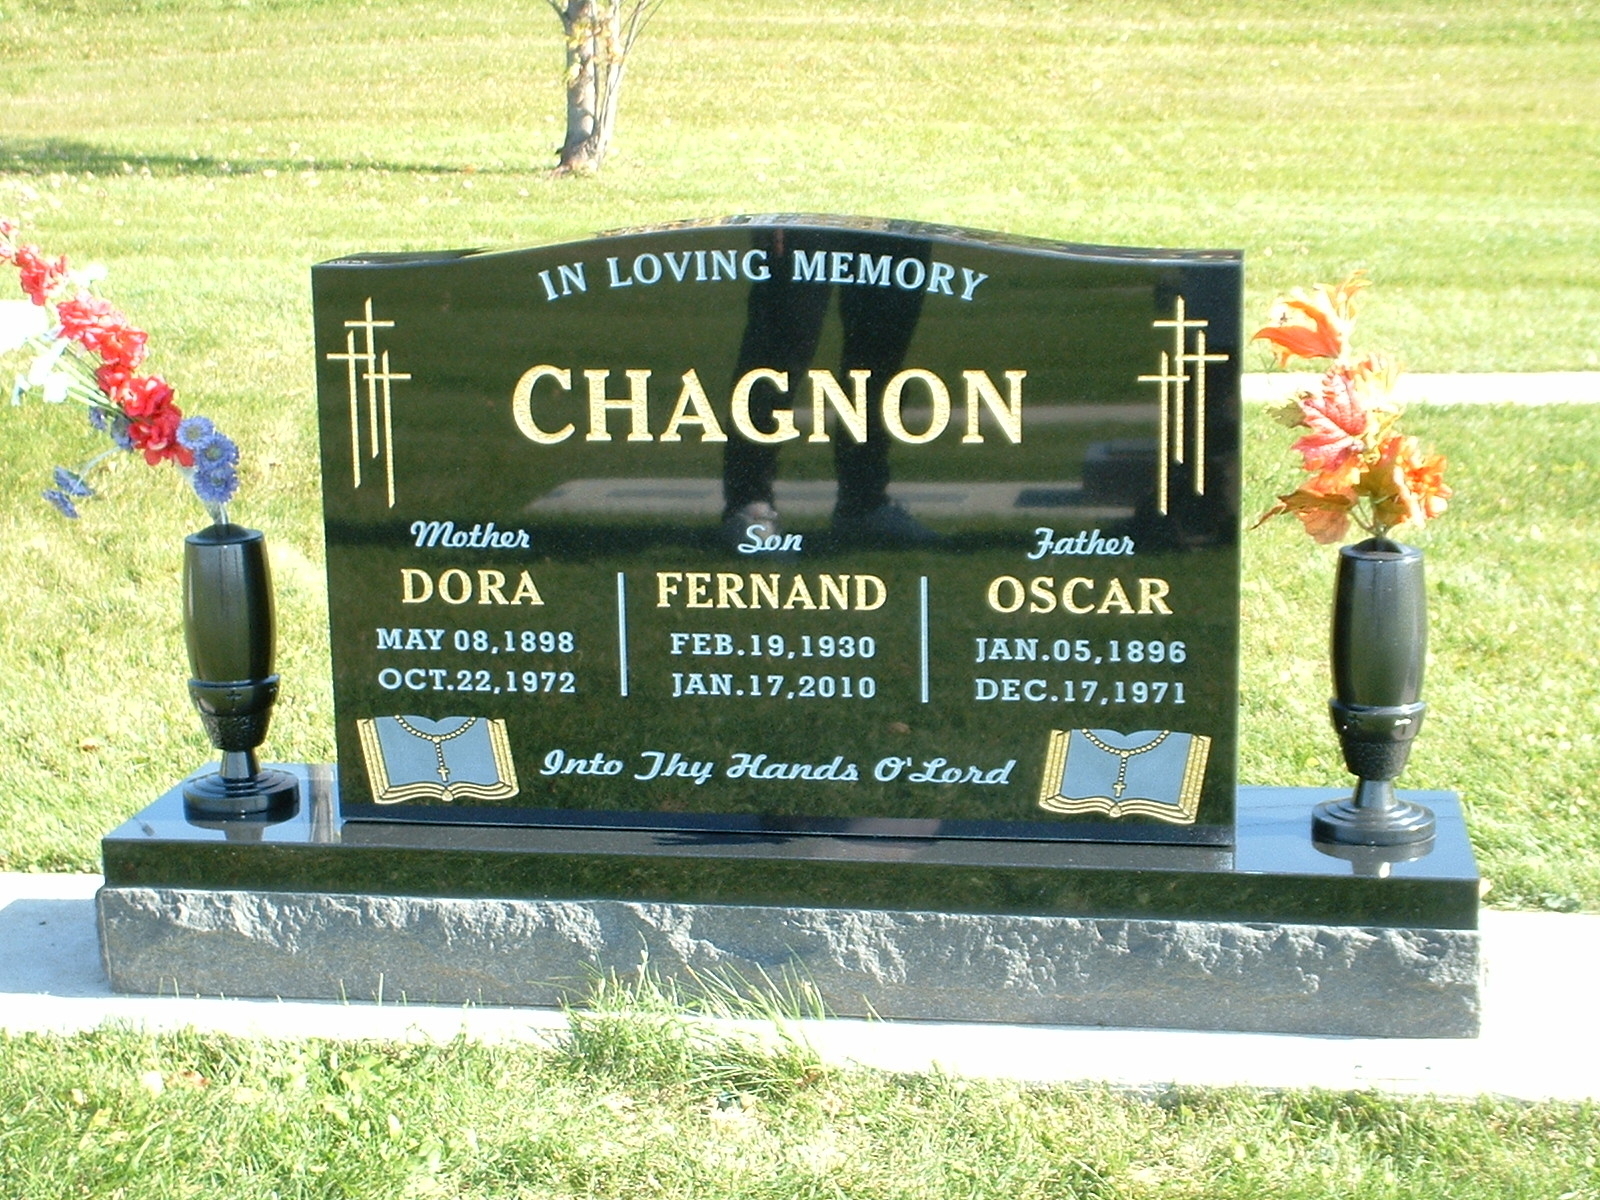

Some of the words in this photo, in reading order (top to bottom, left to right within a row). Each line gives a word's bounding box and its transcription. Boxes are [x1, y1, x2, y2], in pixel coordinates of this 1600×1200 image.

[538, 262, 586, 301] IN
[606, 249, 771, 287] LOVING
[792, 250, 988, 301] MEMORY
[512, 365, 1027, 445] CHAGNON
[410, 521, 529, 548] Mother
[738, 524, 802, 553] Son
[1027, 527, 1134, 560] Father
[401, 569, 544, 605] DORA
[656, 572, 886, 610] FERNAND
[986, 576, 1173, 615] OSCAR
[540, 749, 623, 775] Into
[634, 751, 713, 785] Thy
[726, 753, 858, 781] Hands
